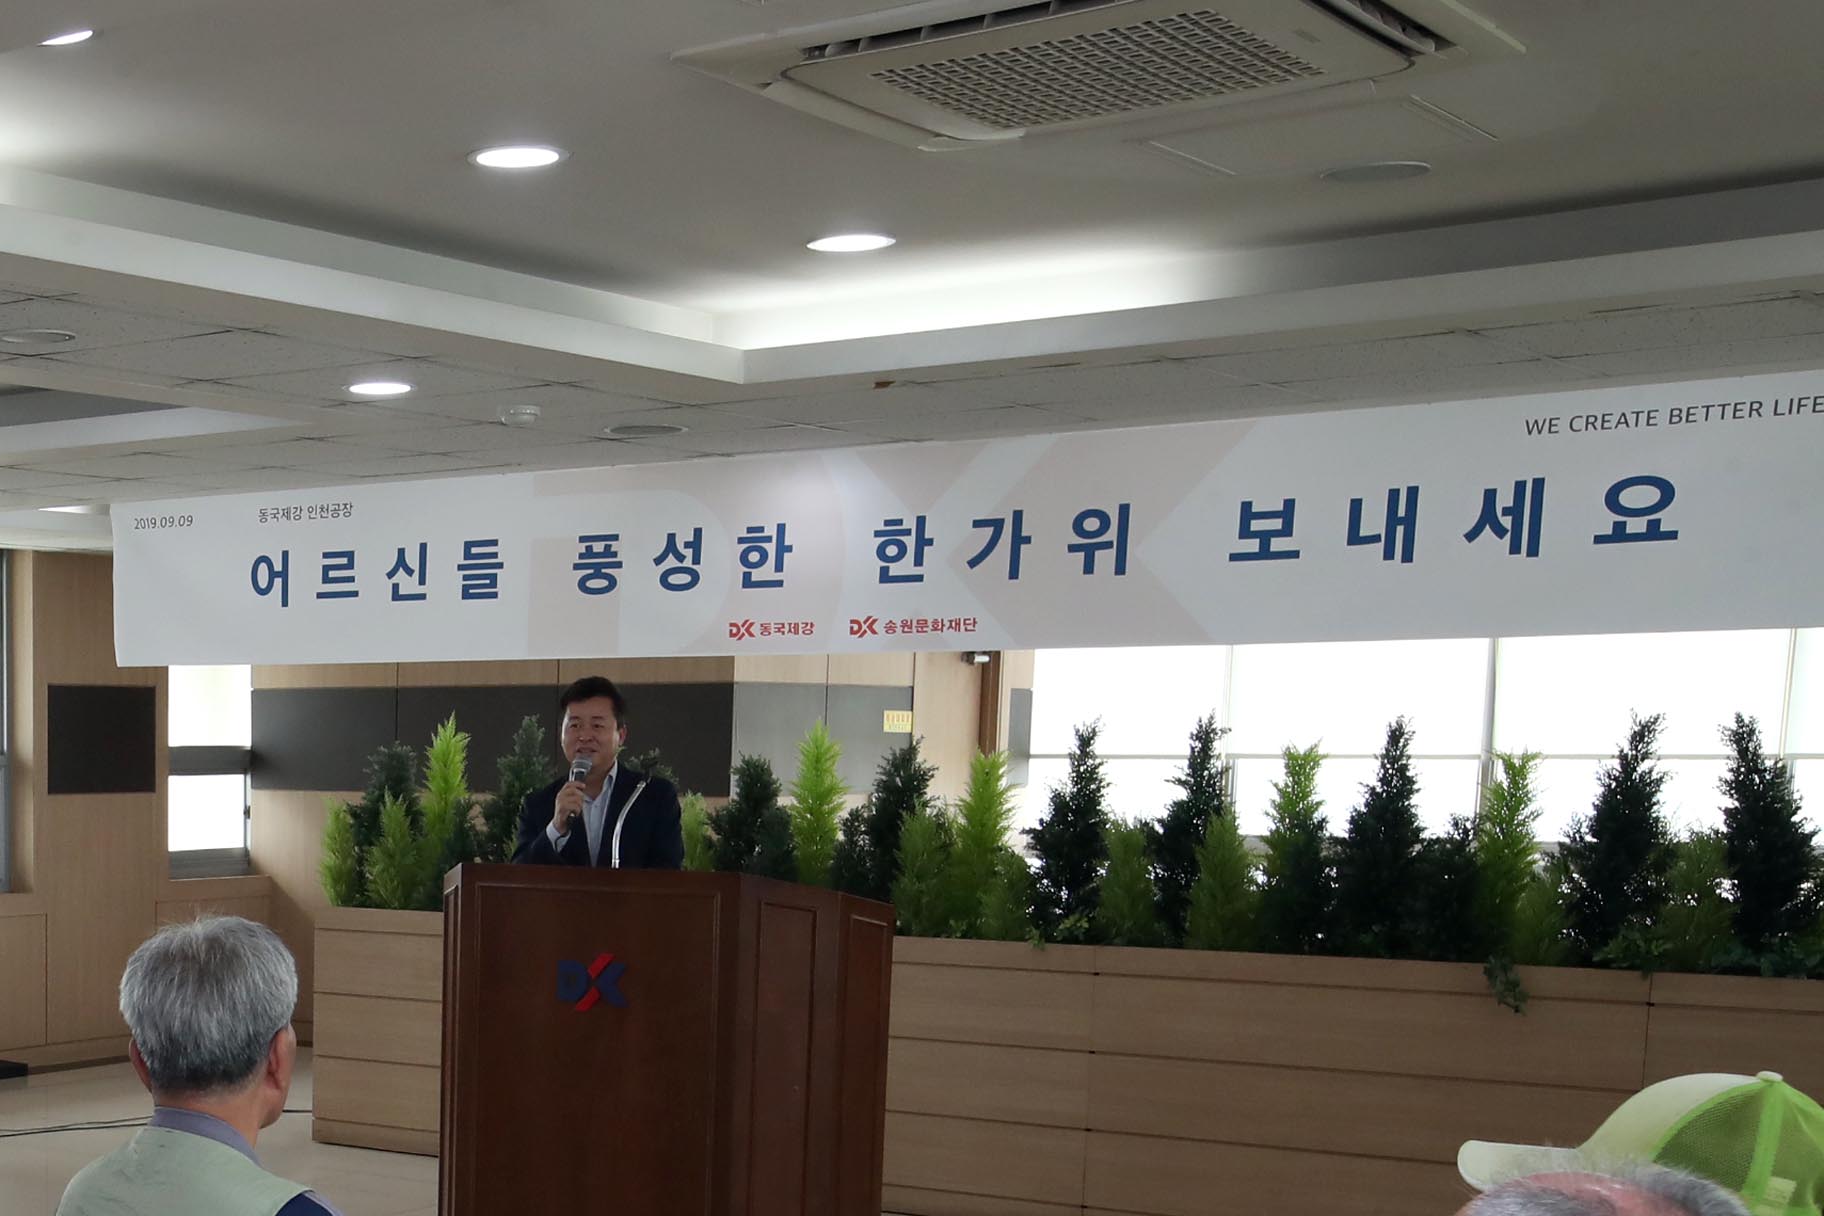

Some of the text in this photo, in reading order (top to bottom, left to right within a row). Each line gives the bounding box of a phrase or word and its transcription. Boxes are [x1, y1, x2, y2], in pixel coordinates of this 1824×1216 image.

[1526, 396, 1824, 435] WE CREATE BETTER LIFE
[259, 501, 353, 523] 동국제강 인천공장
[134, 515, 193, 530] 2019.09.09
[252, 474, 1680, 607] 어르신들 풍성한 한가위 보내세요
[760, 622, 816, 636] 동국제강
[884, 618, 977, 635] 송원문화재단
